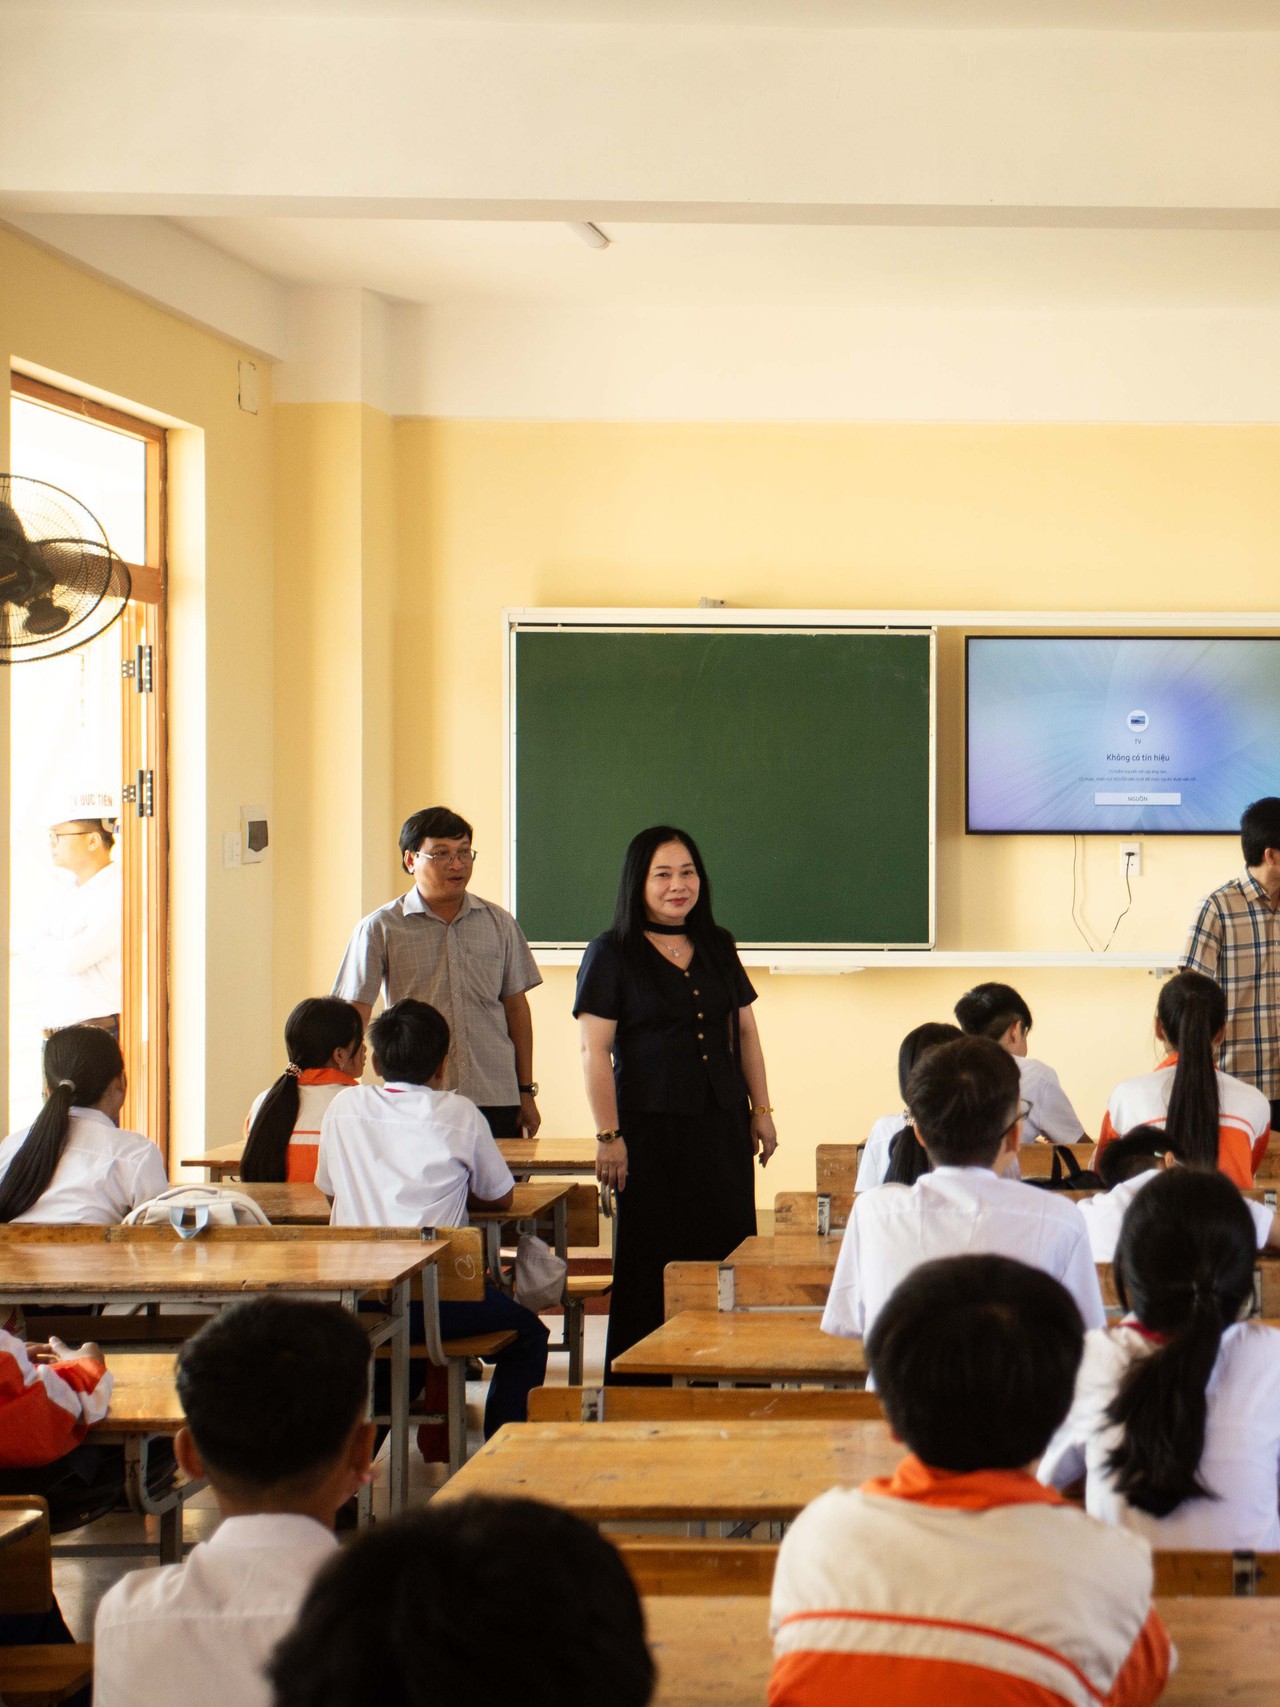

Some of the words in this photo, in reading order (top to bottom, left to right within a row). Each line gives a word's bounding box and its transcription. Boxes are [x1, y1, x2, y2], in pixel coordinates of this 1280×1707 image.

[1106, 753, 1130, 763] Không
[1131, 753, 1141, 761] có
[1142, 753, 1152, 761] tín
[1153, 753, 1170, 763] hiệu
